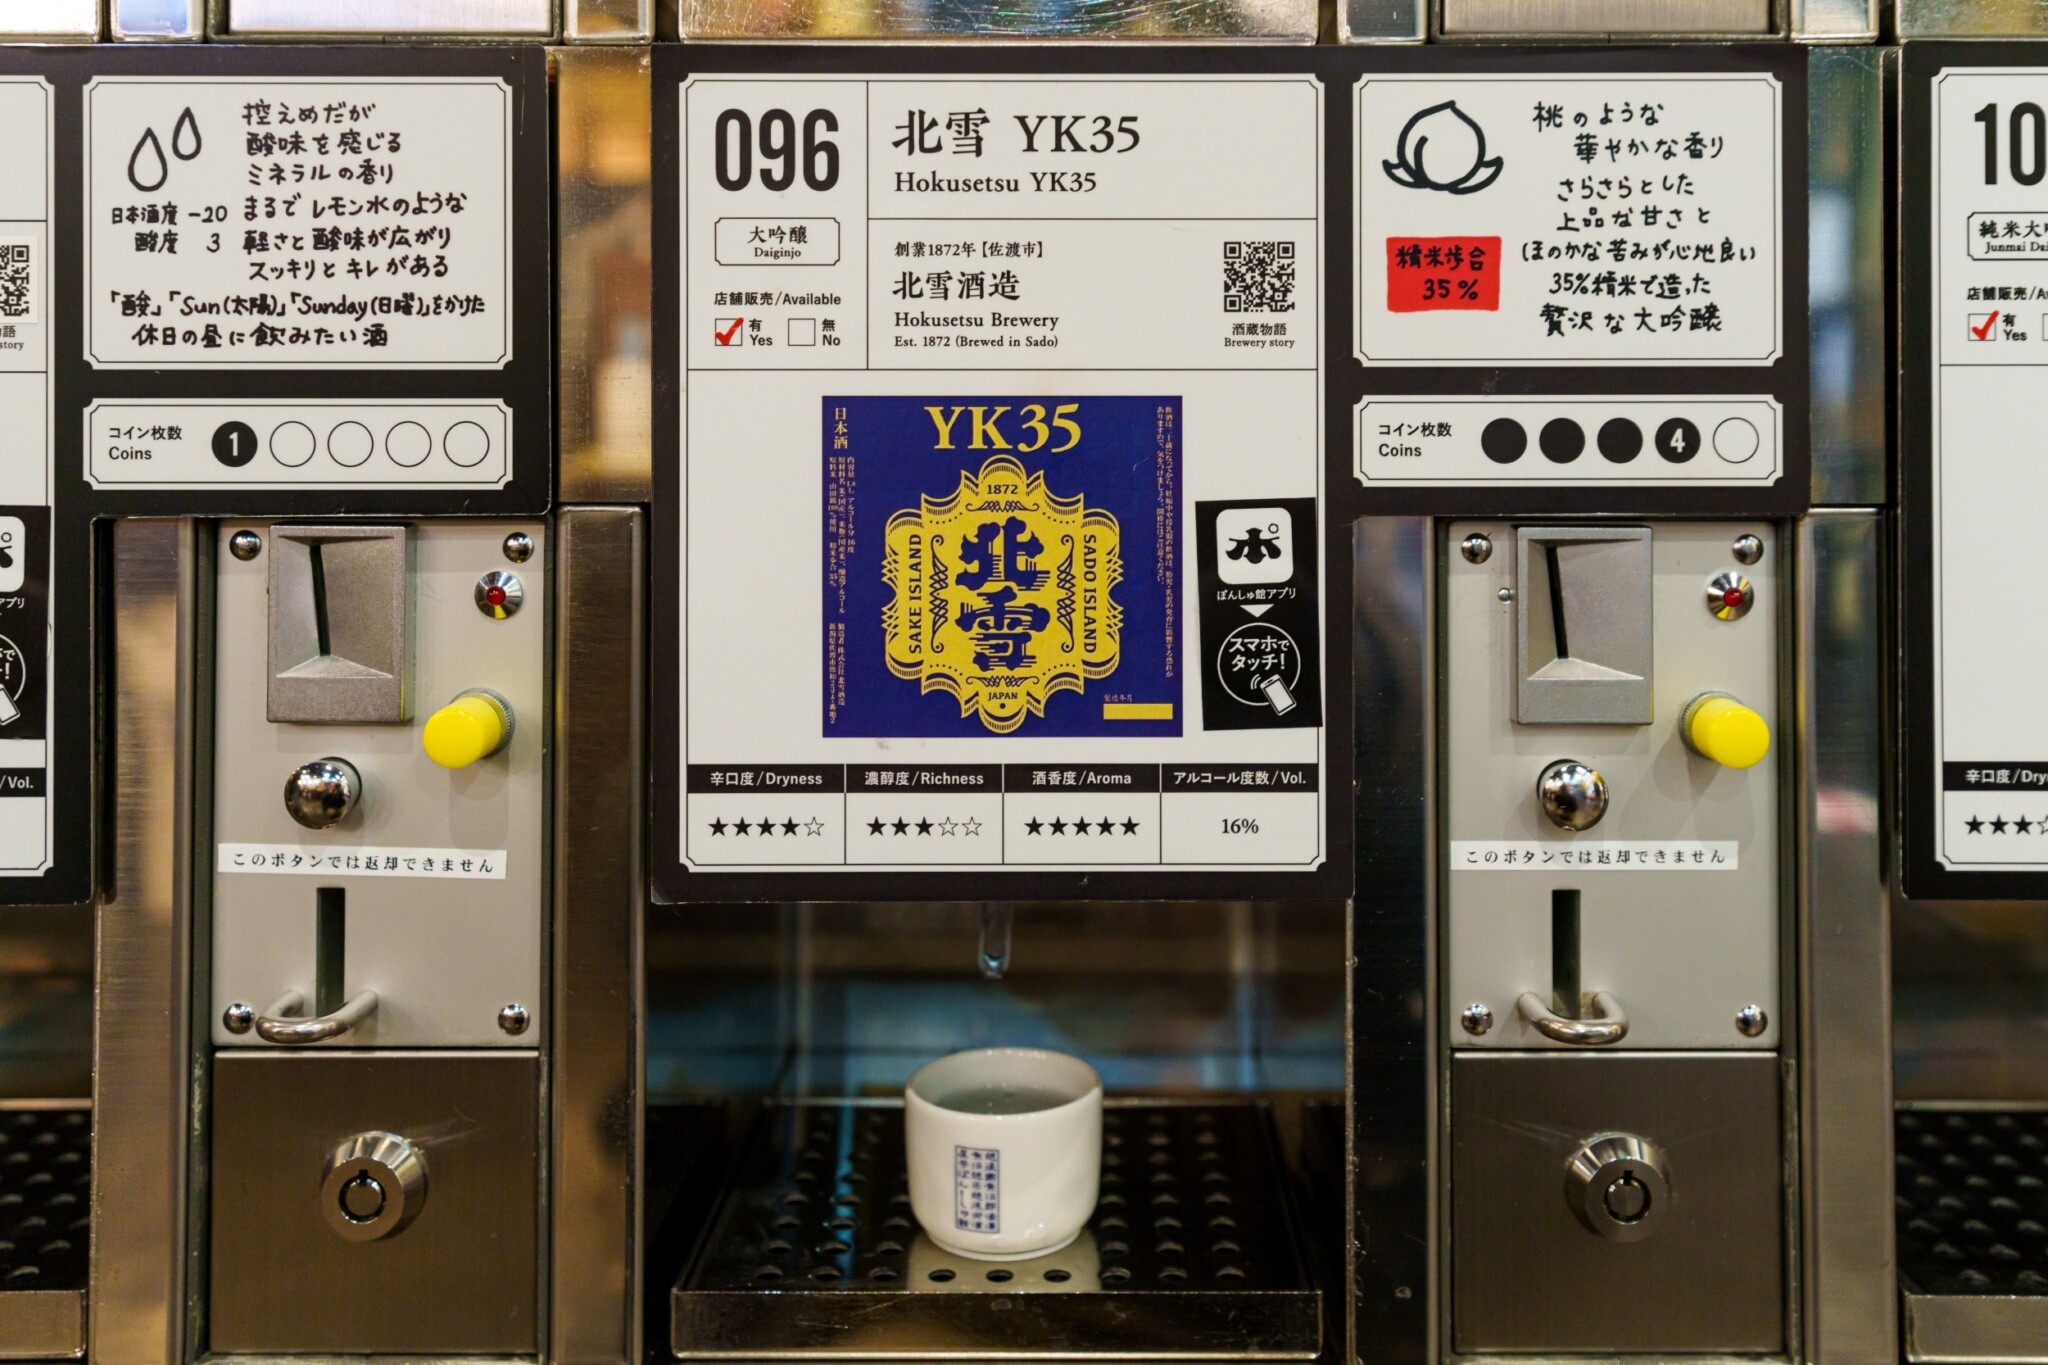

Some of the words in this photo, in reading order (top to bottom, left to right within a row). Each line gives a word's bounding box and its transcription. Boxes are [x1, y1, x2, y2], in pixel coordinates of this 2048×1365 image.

[242, 99, 375, 126] 控えめだが
[1533, 101, 1663, 131] 桃のような
[892, 108, 990, 157] 北雪
[1014, 116, 1139, 153] YK35
[247, 130, 400, 157] 酸味を感じる
[715, 109, 839, 191] 096
[1574, 132, 1723, 164] 華やかな香り
[249, 158, 393, 185] ミネラルの香り
[895, 171, 1019, 192] Hokusetsu
[1030, 172, 1096, 192] YK35
[1558, 174, 1693, 201] さらさらとした
[112, 201, 177, 225] 日本酒度
[1557, 205, 1709, 232] 上品な甘さと
[748, 225, 807, 244] 大吟醸
[1979, 220, 2048, 239] 純米大
[135, 229, 178, 254] 酸度
[207, 233, 220, 253] 3
[243, 225, 450, 254] 軽さと酸味が広がり
[1985, 242, 2025, 254] Junmai
[755, 247, 801, 259] Daiginjo
[895, 241, 1042, 258] 創業1872年【佐渡市】
[1396, 244, 1485, 271] 精米歩合
[893, 270, 1020, 300] 北雪酒造
[1423, 279, 1478, 300] 35%
[1967, 286, 2048, 301] 店舗販売/A
[714, 292, 841, 305] 店舗販売/Available
[749, 319, 762, 332] 有
[822, 319, 835, 331] 無
[895, 311, 983, 326] Hokusetsu
[992, 312, 1059, 331] Brewery
[1540, 302, 1721, 336] 贅沢な大吟醸
[2003, 313, 2016, 327] 有
[0, 325, 16, 338] 語
[132, 322, 387, 348] 休日の昼に飲みたい酒
[1233, 323, 1286, 335] 酒蔵物語
[2004, 329, 2027, 341] Yes
[750, 335, 772, 346] Yes
[823, 335, 840, 345] No
[895, 336, 916, 346] Est.
[924, 336, 950, 346] 1872
[956, 336, 1003, 347] (Brewed
[1009, 336, 1020, 346] in
[1026, 336, 1058, 347] Sado)
[1225, 338, 1266, 348] Brewery
[1270, 339, 1295, 348] story
[110, 426, 182, 440] コイン枚数
[834, 408, 847, 449] 日本酒
[924, 404, 1081, 452] YK35
[1380, 423, 1451, 437] コイン枚数
[230, 432, 238, 456] 1
[1670, 428, 1685, 452] 4
[109, 447, 152, 460] Coins
[1379, 444, 1421, 456] Coins
[988, 484, 1018, 494] 1872
[909, 534, 921, 600] ISLAND
[1084, 535, 1096, 582] SADO
[909, 607, 921, 653] SAKE
[1084, 588, 1096, 653] ISLAND
[1229, 636, 1290, 653] スマホで
[988, 692, 1017, 701] JAPAN
[711, 771, 822, 787] 辛口度/Dryness
[865, 771, 983, 785] 濃醇度/Richness
[1033, 771, 1131, 785] 酒香度/Aroma
[1174, 771, 1306, 785] アルコール度数/Vol.
[1965, 769, 2048, 785] 辛口度/Dry
[1223, 819, 1258, 833] 16%
[235, 853, 492, 872] このボタンでは返却できません
[1468, 850, 1724, 864] このボタンでは返却できません
